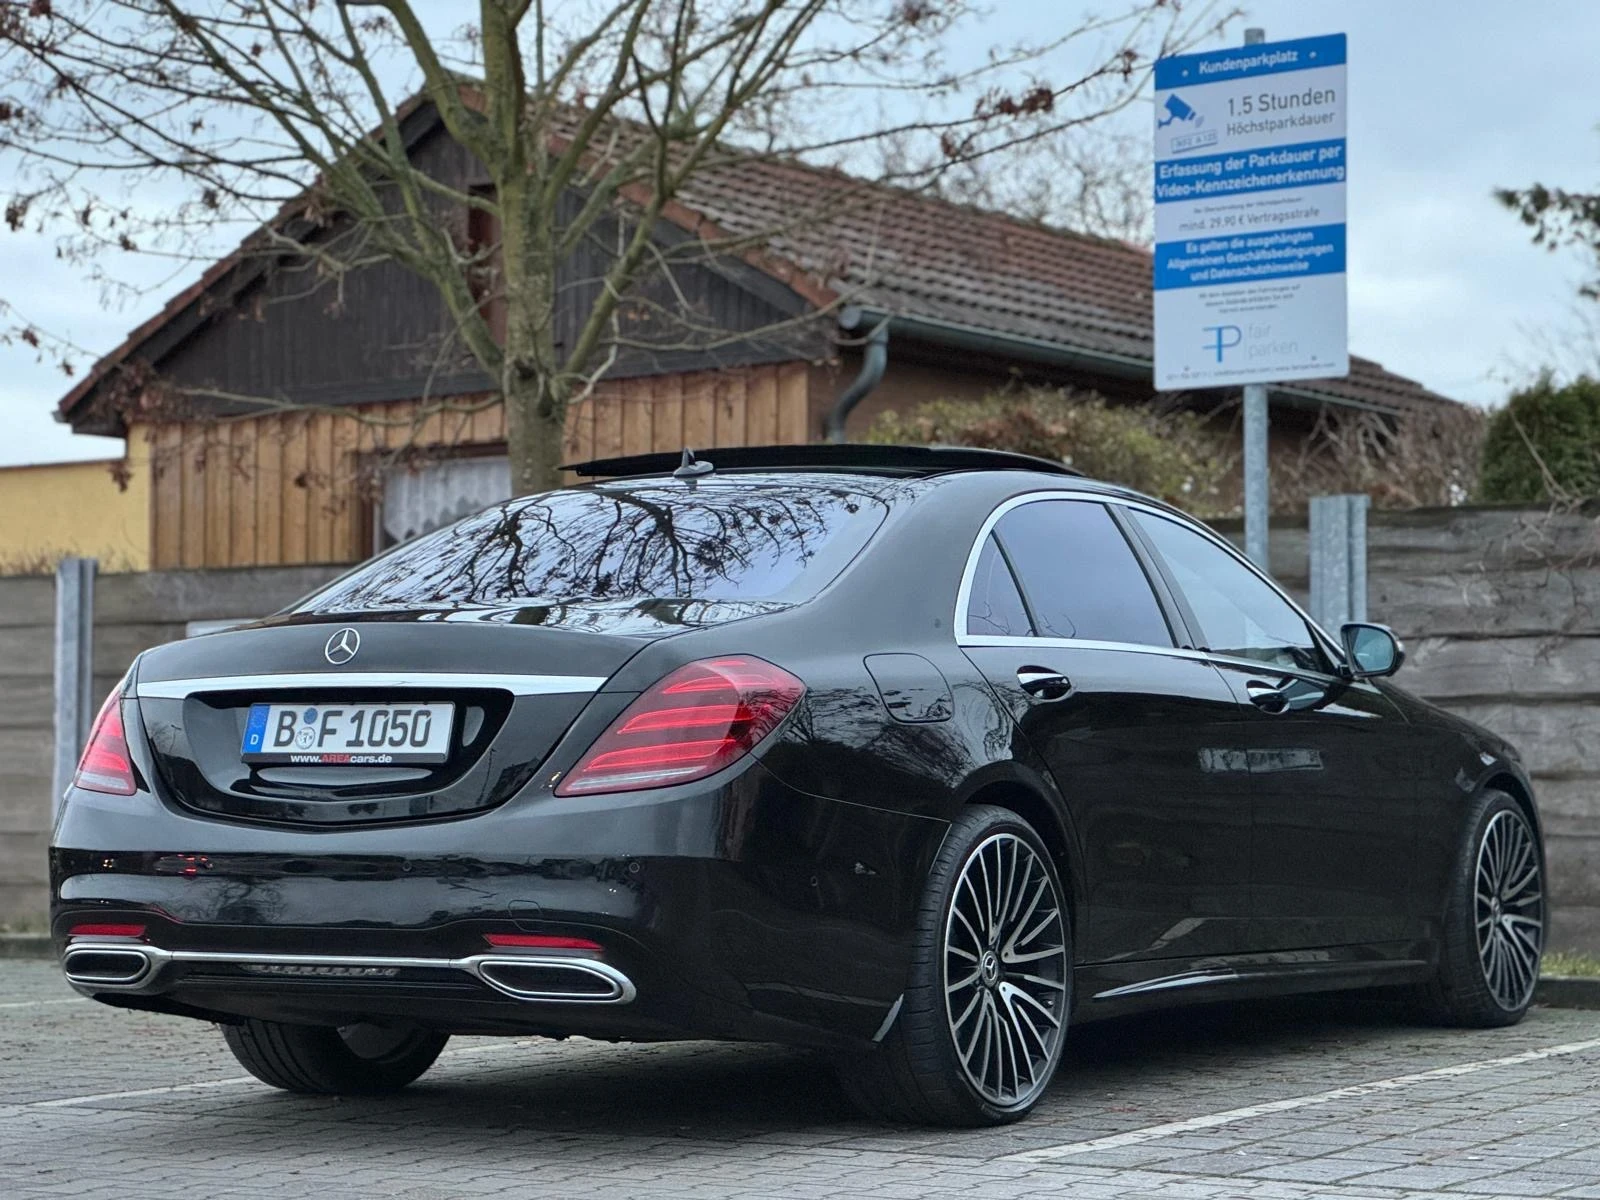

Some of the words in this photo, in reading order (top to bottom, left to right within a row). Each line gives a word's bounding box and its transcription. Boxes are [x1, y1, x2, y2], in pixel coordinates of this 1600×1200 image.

[1199, 51, 1298, 75] Kundenparkplatz
[1259, 88, 1336, 112] Stunden
[1226, 112, 1335, 136] Höchstparkdauer
[1159, 161, 1222, 179] Erfassung
[1225, 157, 1246, 170] der
[1249, 148, 1316, 168] Parkdauer
[1318, 145, 1342, 163] per
[1156, 166, 1345, 199] Video-Kennzeichenerkennung
[1247, 206, 1320, 224] Vertragsstrafe
[1190, 270, 1210, 281] und
[1248, 341, 1298, 361] parken
[250, 734, 259, 745] D
[273, 710, 298, 748] B
